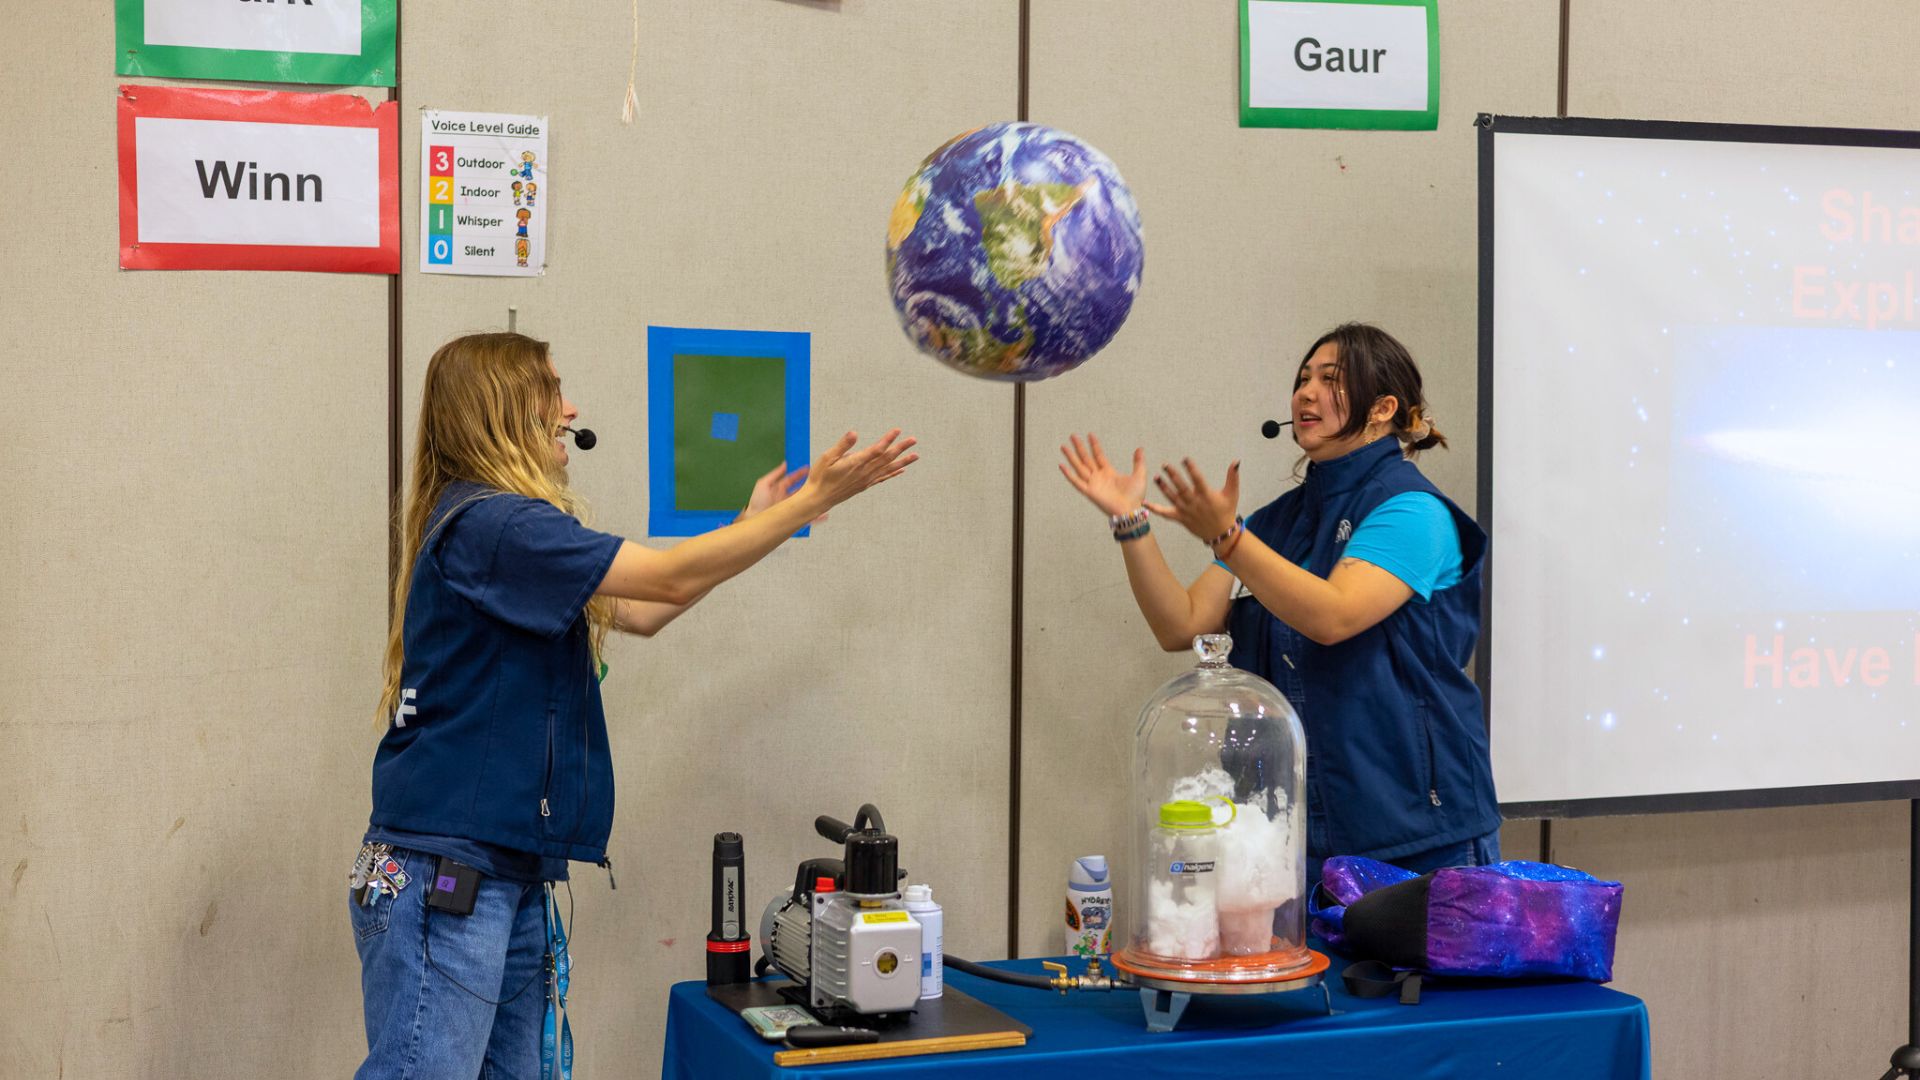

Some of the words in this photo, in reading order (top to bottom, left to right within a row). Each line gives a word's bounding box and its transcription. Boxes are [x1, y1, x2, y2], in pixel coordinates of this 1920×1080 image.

[1294, 37, 1387, 73] Gaur
[431, 120, 466, 132] Voice
[470, 121, 504, 134] Level
[507, 123, 540, 136] Guide
[435, 151, 449, 172] 3
[457, 157, 505, 169] Outdoor
[195, 160, 323, 203] Winn
[435, 180, 449, 200] 2
[460, 186, 501, 198] Indoor
[438, 209, 445, 229] 1
[457, 215, 504, 229] Whisper
[434, 239, 449, 260] 0
[464, 245, 496, 257] Silent
[1744, 634, 1890, 688] Have
[727, 880, 735, 913] RAYOVAC
